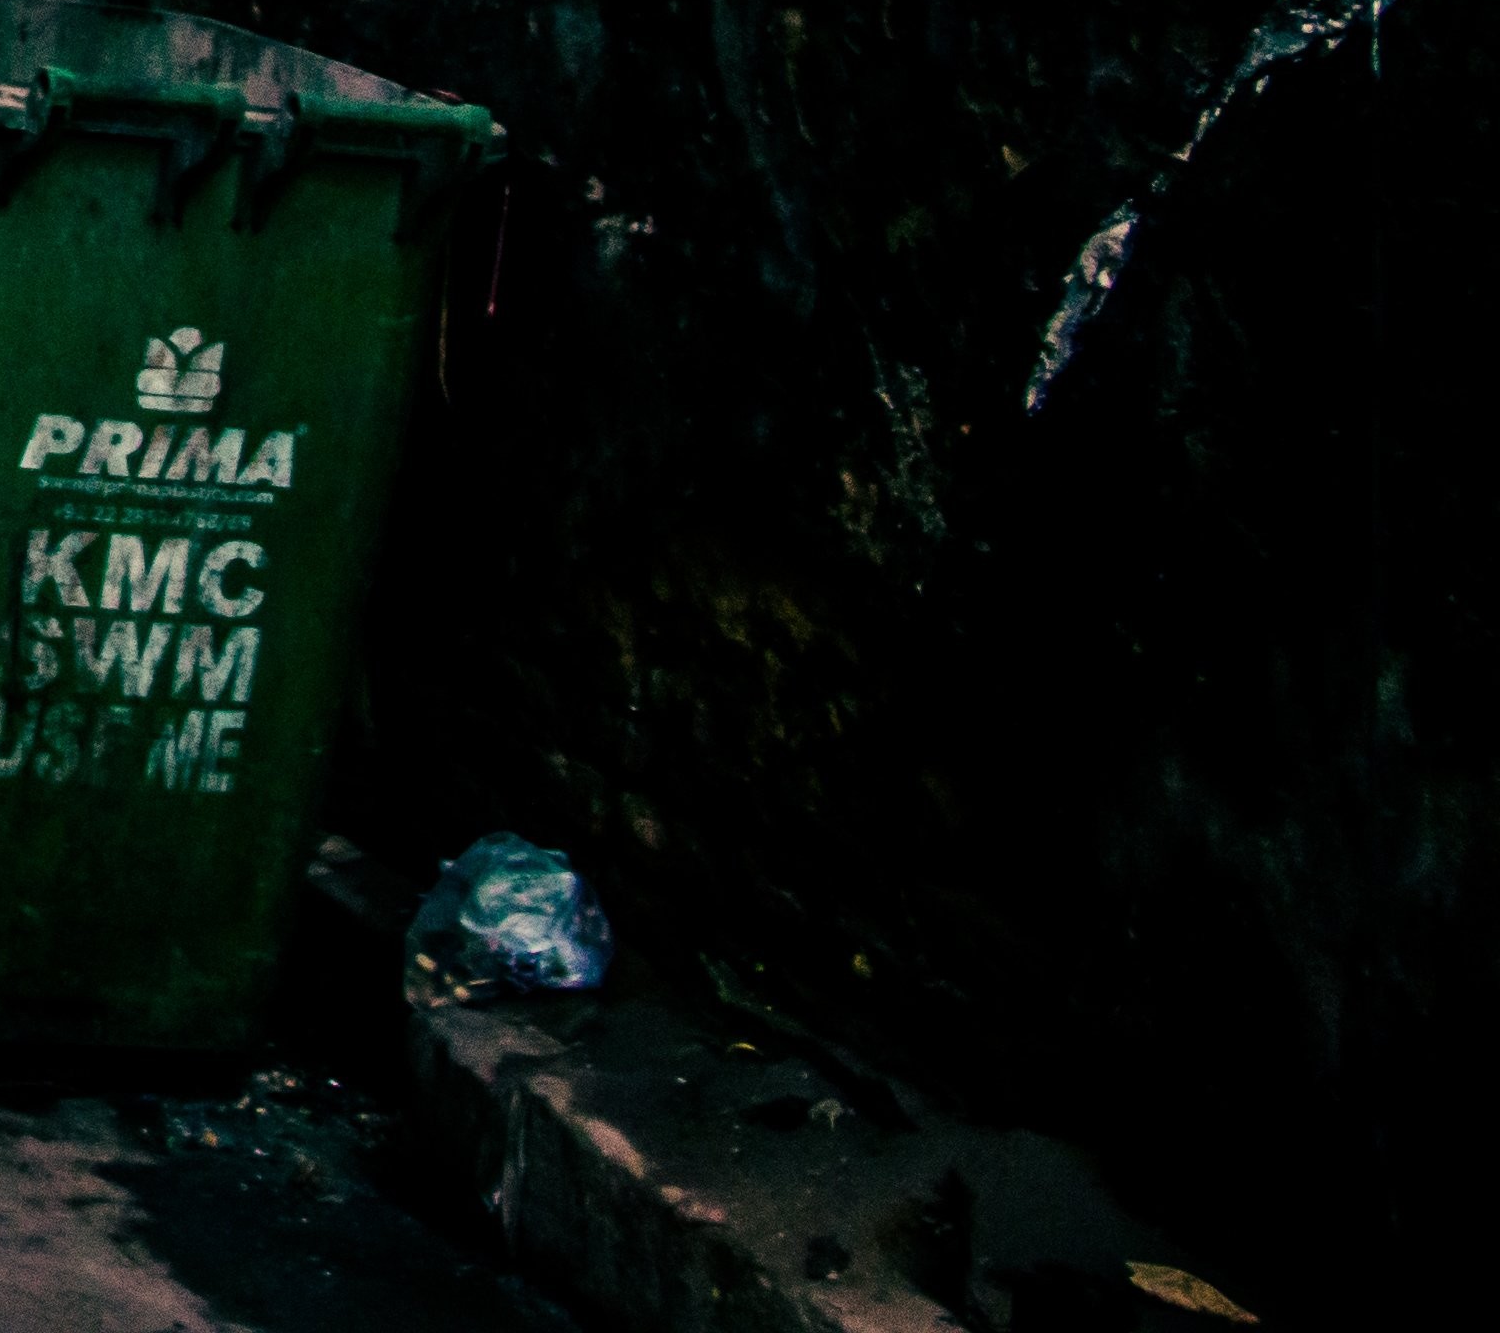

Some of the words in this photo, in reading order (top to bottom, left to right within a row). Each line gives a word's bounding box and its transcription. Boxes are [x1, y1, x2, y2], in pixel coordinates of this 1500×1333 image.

[20, 413, 294, 488] PRIMA
[22, 529, 267, 618] KMC
[146, 709, 247, 793] ME
